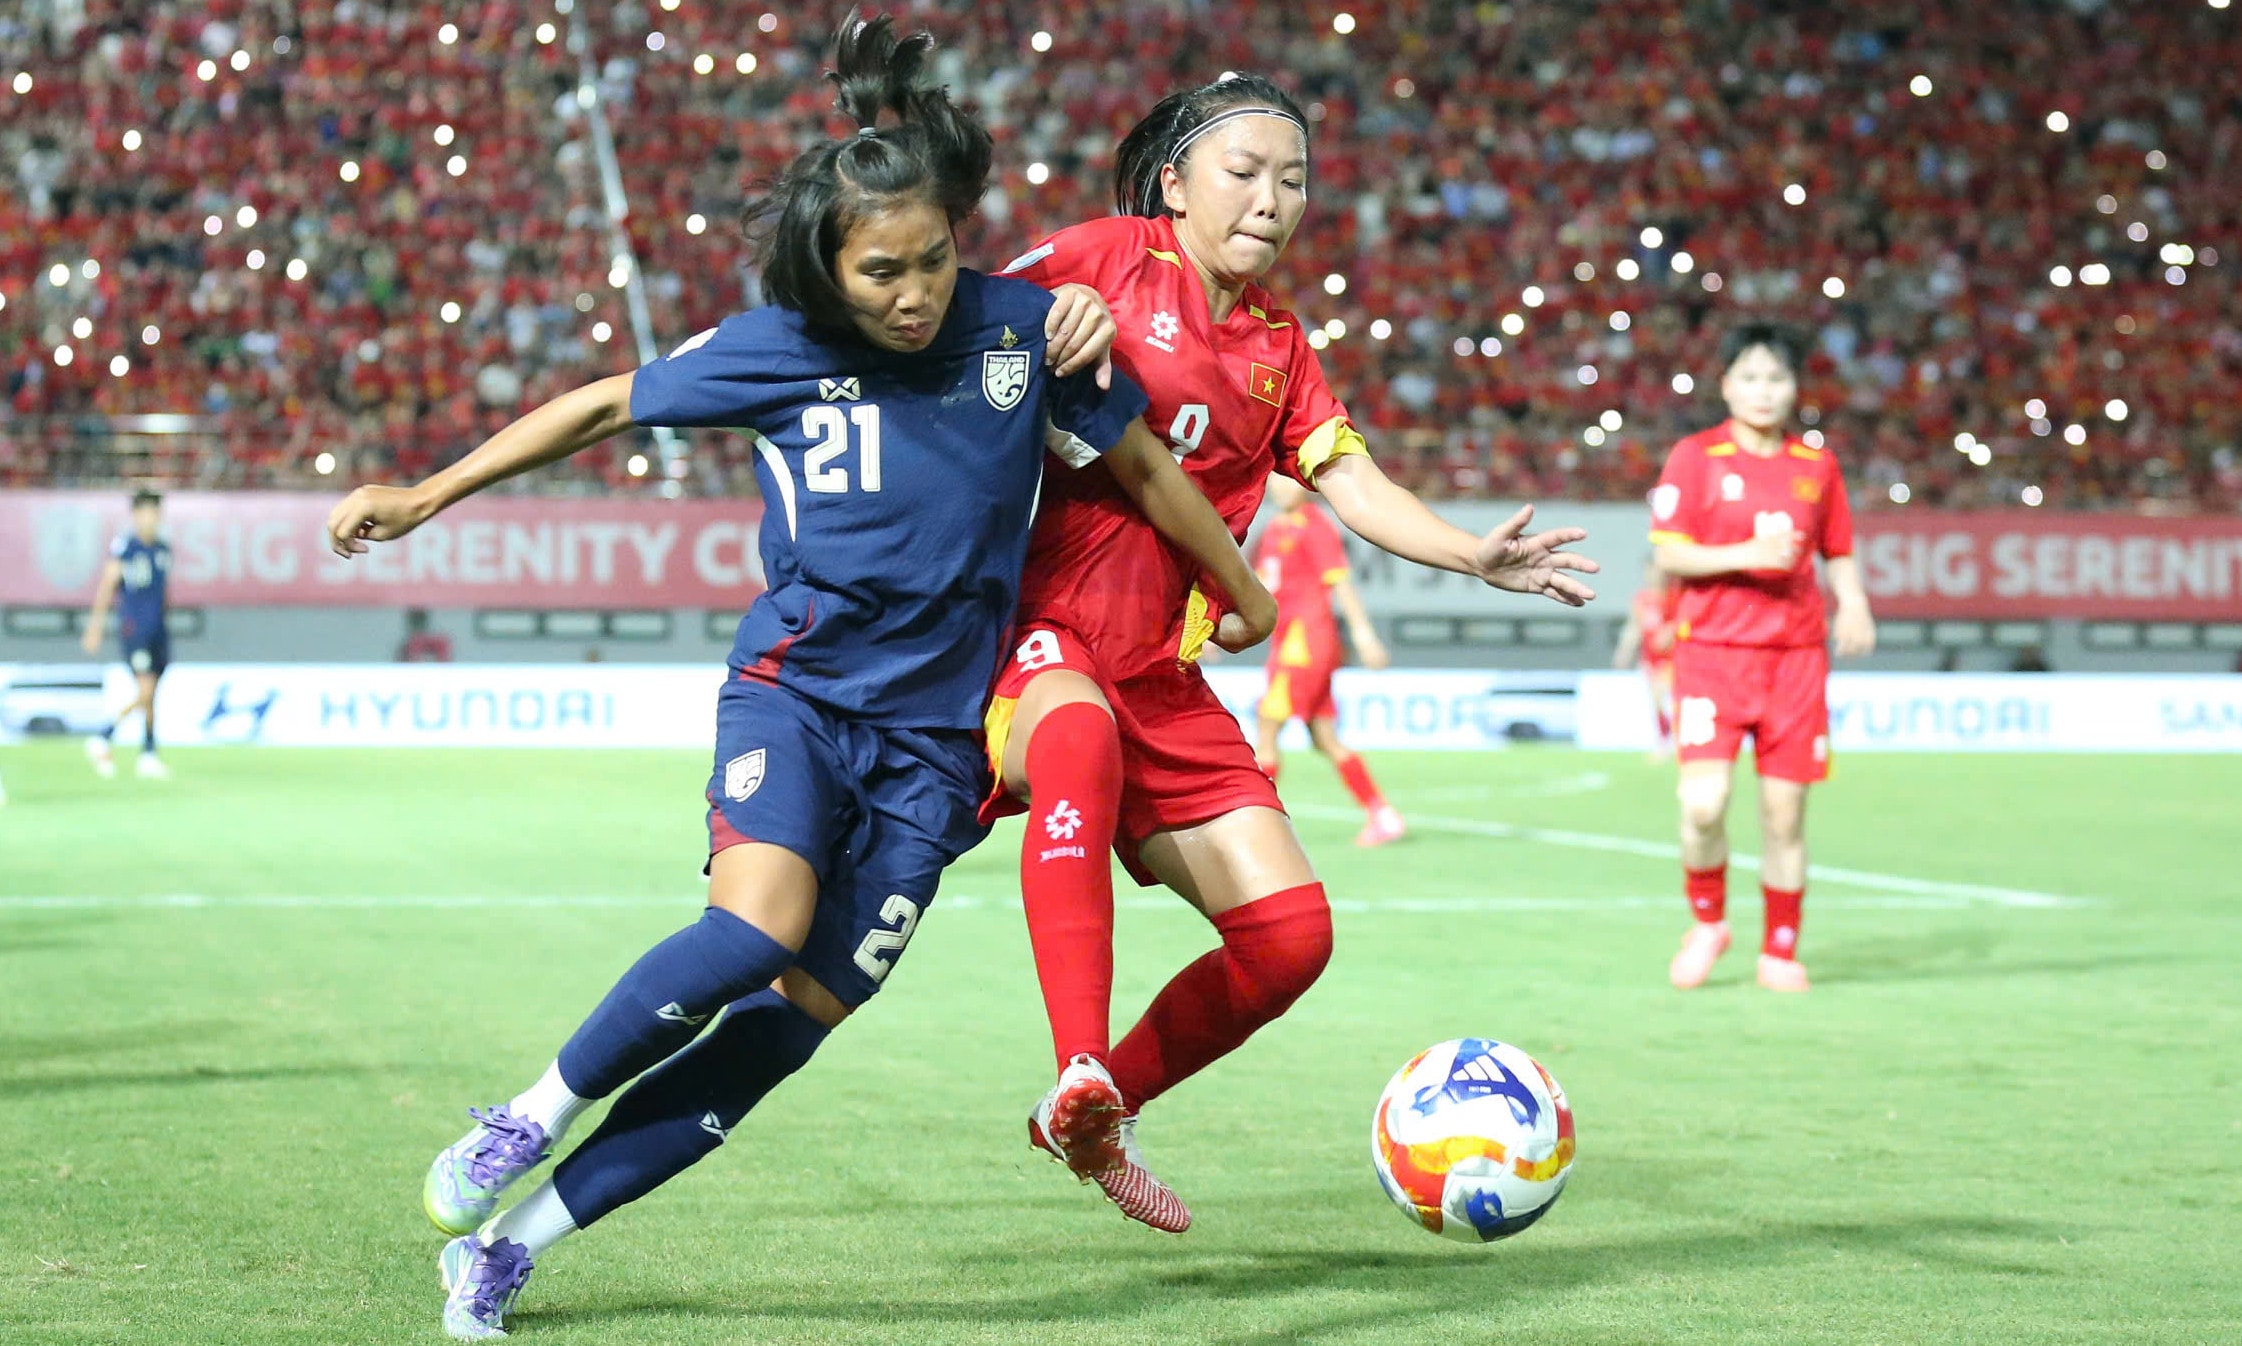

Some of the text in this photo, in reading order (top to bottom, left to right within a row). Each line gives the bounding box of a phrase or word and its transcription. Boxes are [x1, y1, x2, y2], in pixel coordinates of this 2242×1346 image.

[988, 355, 1026, 363] THAILAND
[801, 403, 881, 493] 21
[1169, 404, 1210, 466] 9
[158, 519, 300, 587] SIG
[1991, 533, 2242, 597] SERENI
[1016, 629, 1064, 673] 9
[319, 688, 614, 732] HYUNDAI
[1826, 696, 2051, 736] YUNDAI
[853, 894, 919, 983] 2
